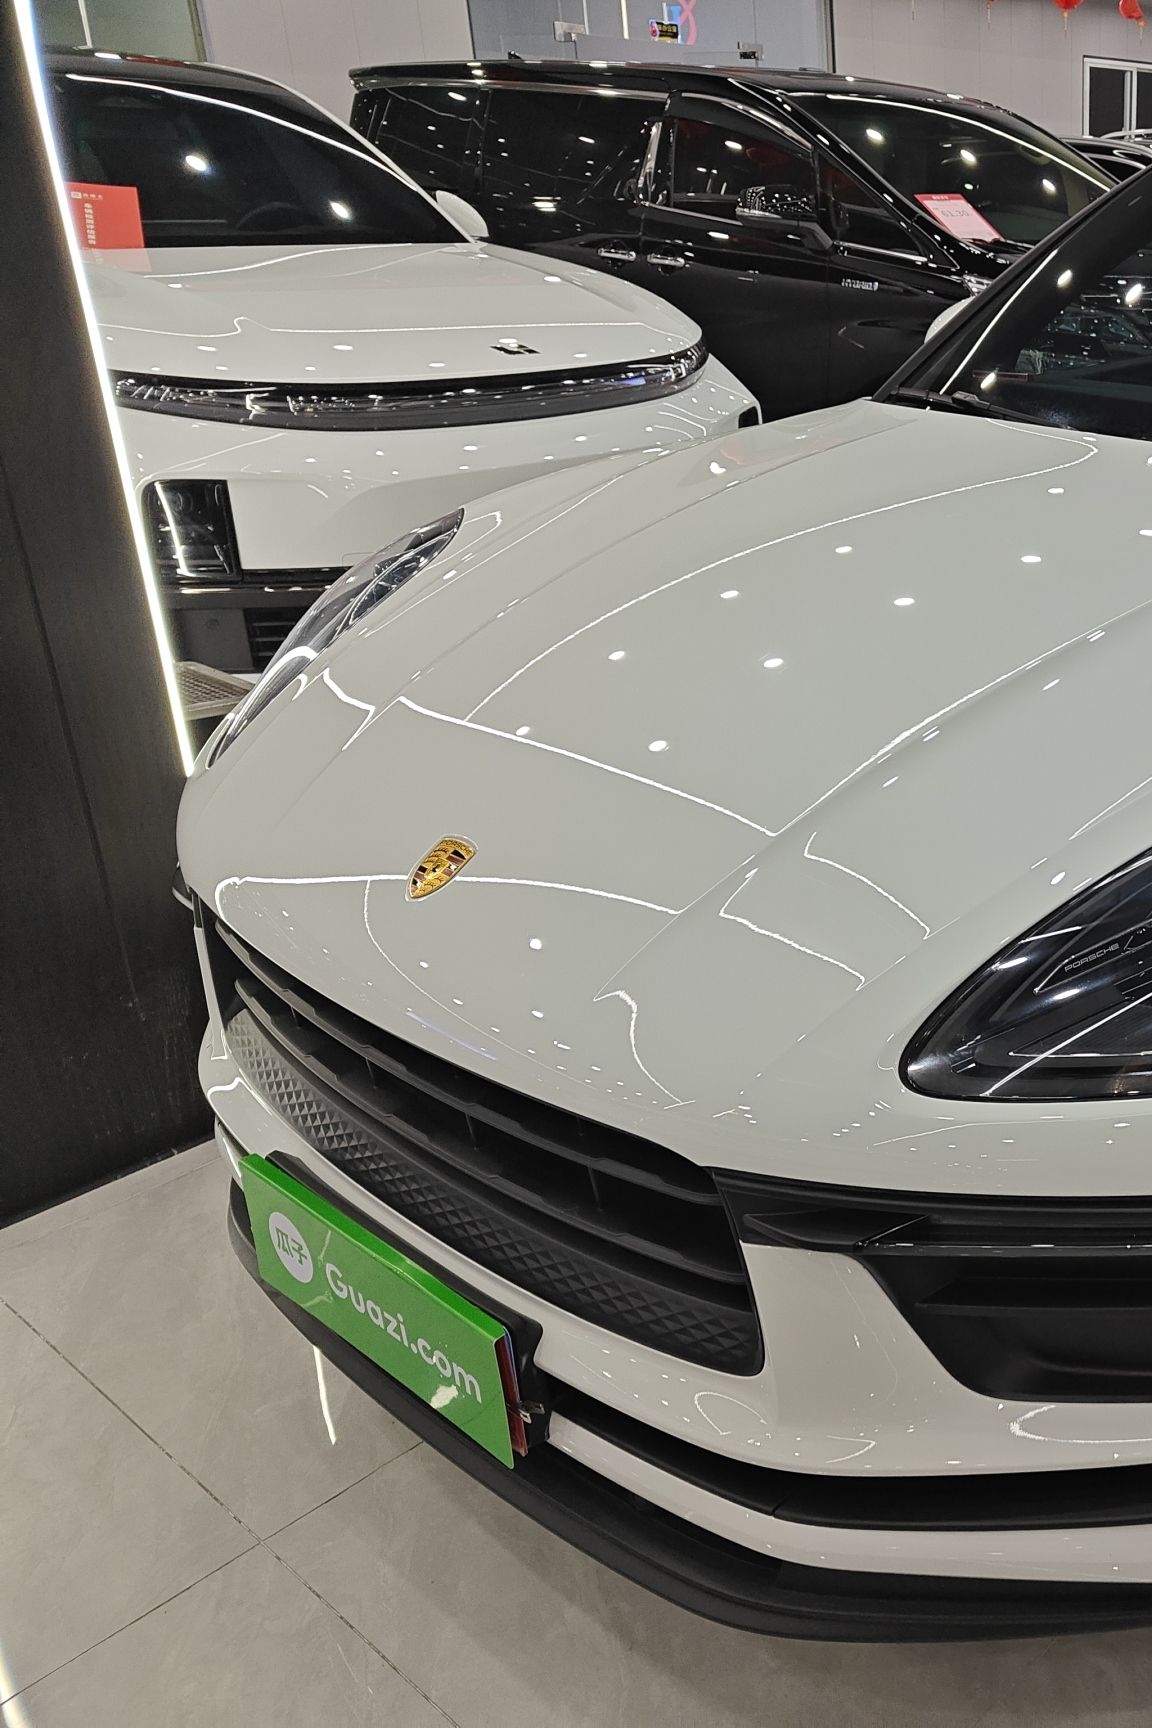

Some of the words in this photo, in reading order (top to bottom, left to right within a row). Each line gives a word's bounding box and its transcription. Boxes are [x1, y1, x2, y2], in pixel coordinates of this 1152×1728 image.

[1064, 942, 1119, 972] PORSCHE
[275, 1227, 307, 1266] 瓜子
[325, 1262, 482, 1404] Guazi.com
